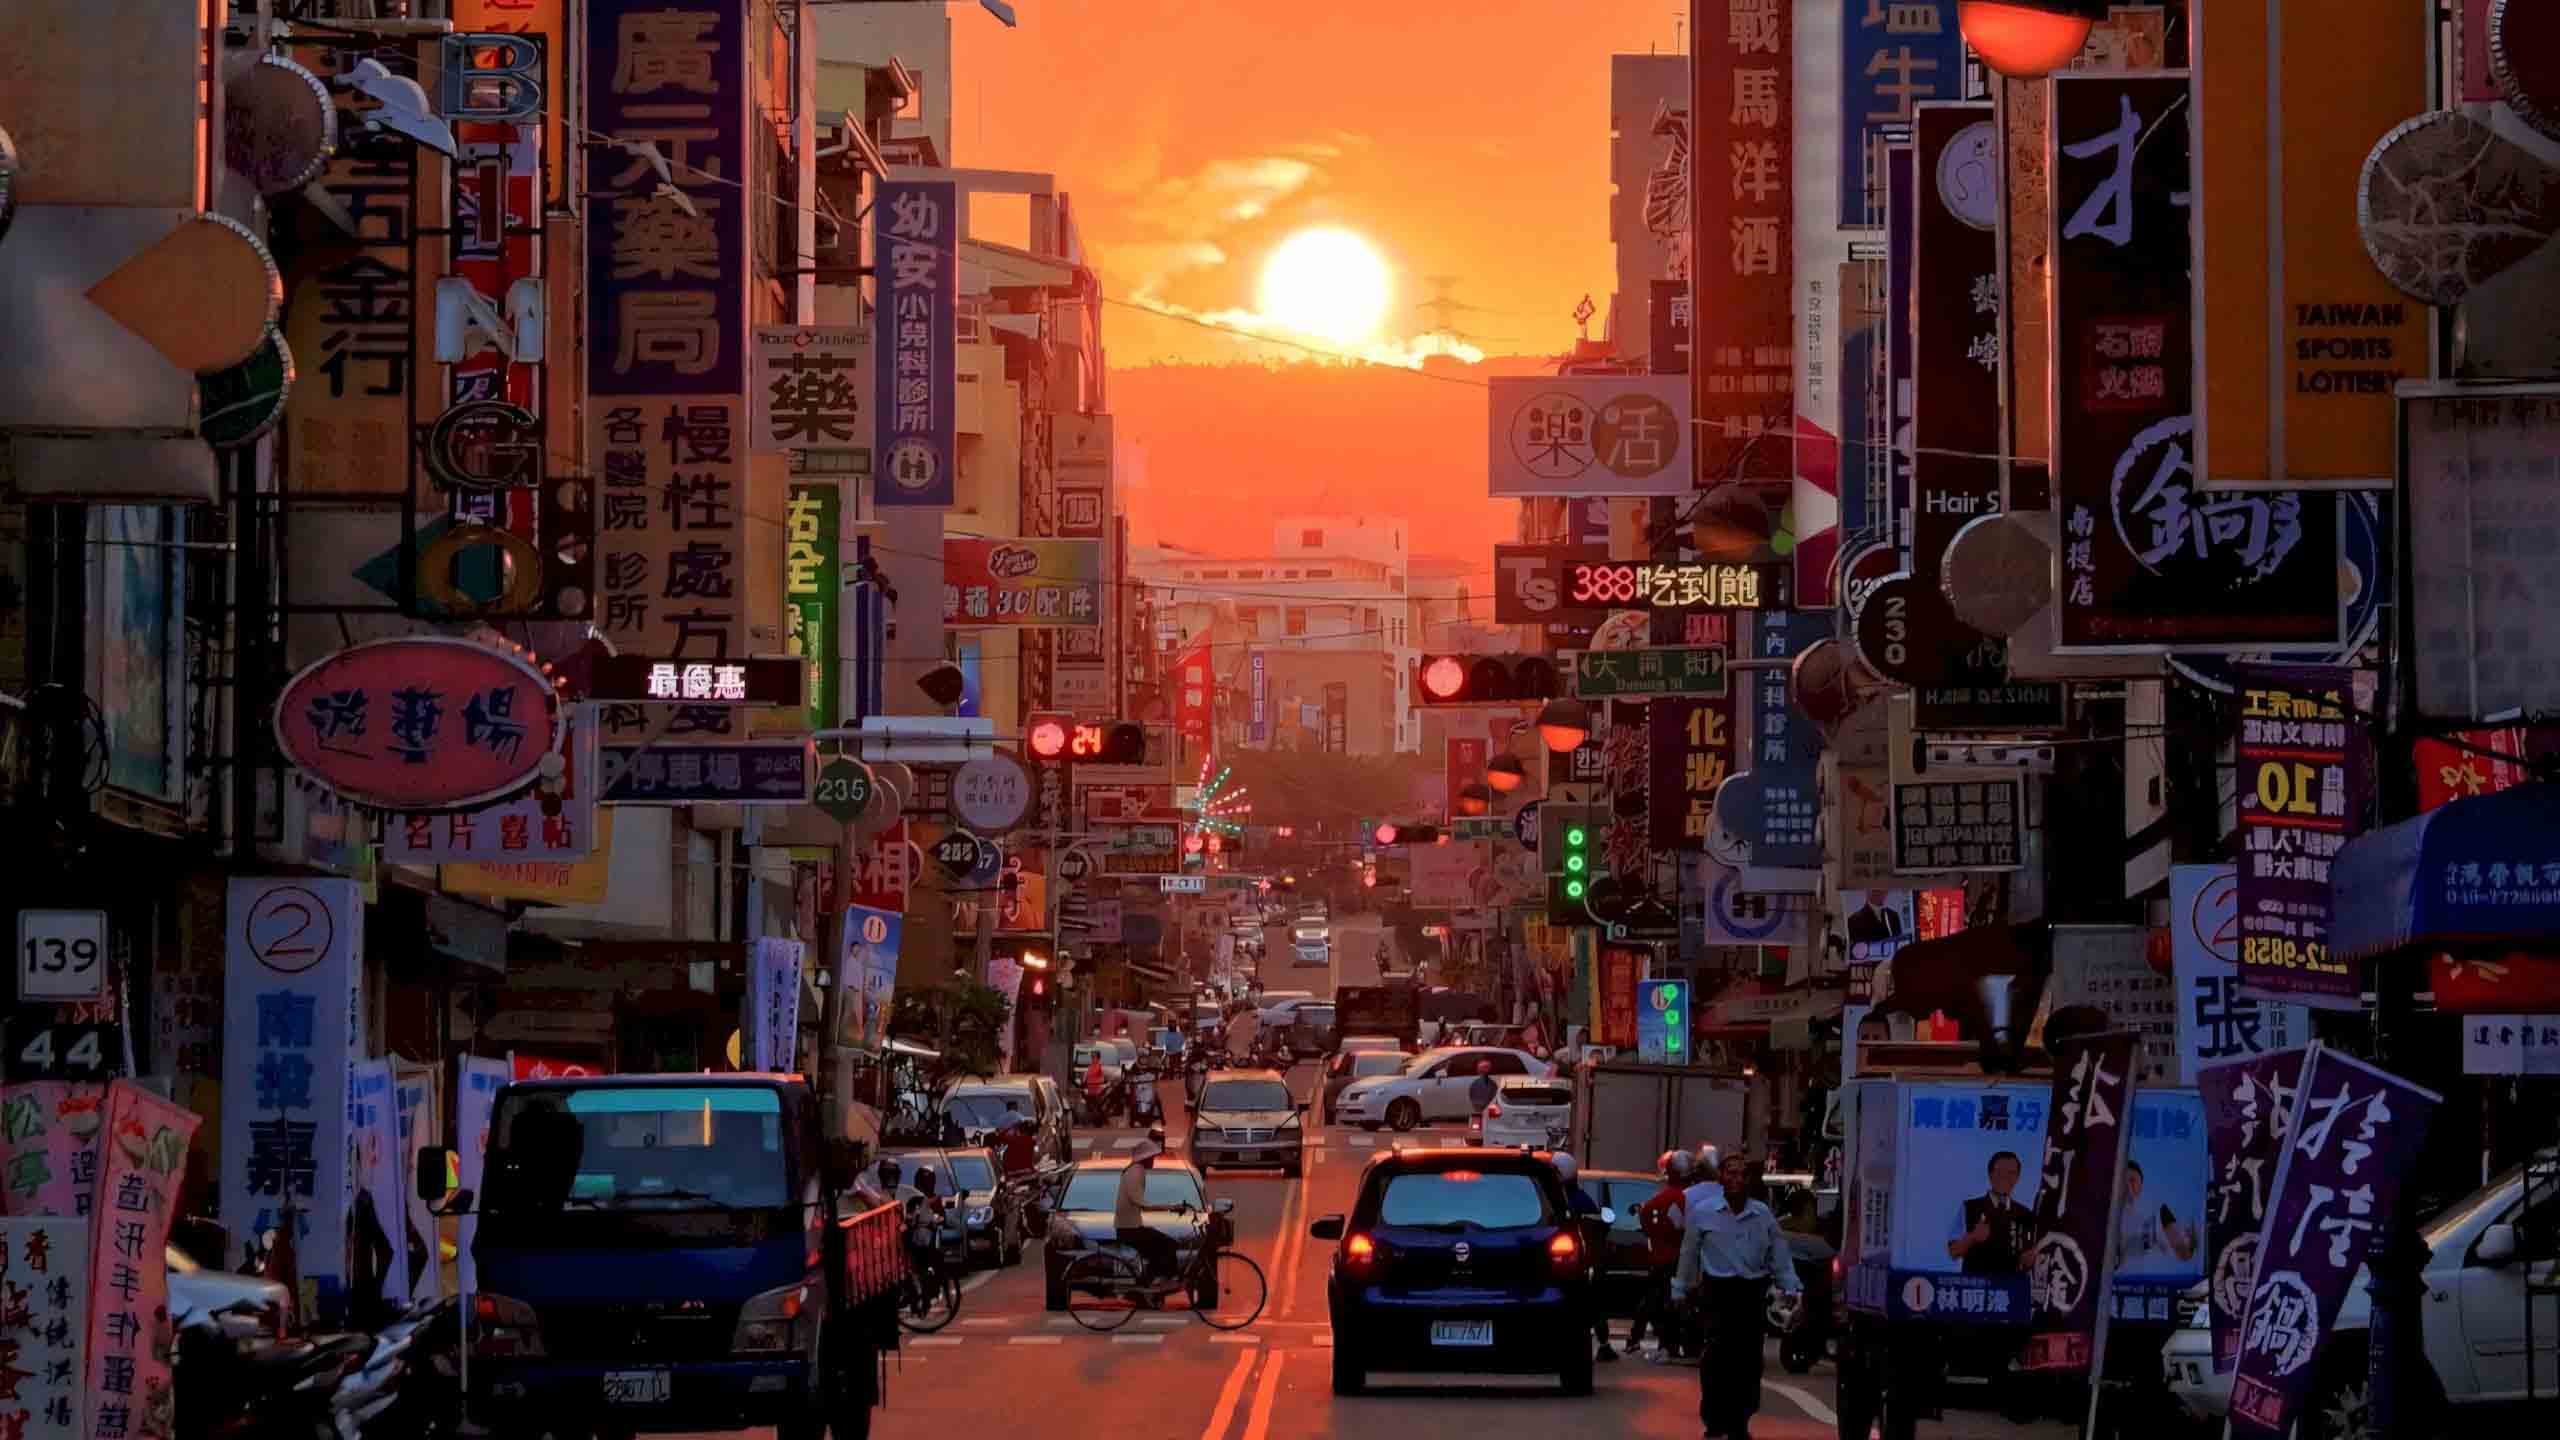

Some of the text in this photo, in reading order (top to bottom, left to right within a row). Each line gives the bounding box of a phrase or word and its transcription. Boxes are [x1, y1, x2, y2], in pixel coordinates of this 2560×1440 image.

[610, 8, 722, 377] 廣元藥局
[2296, 303, 2404, 327] TAIWAN
[2296, 337, 2392, 360] SPORTS
[768, 354, 856, 441] 藥
[2297, 369, 2404, 393] LOTTERY
[1528, 403, 1666, 469] 樂活
[1926, 490, 1979, 513] Hair
[1572, 563, 1761, 608] 388吃到飽
[647, 662, 747, 699] 最優惠
[26, 938, 97, 972] 139
